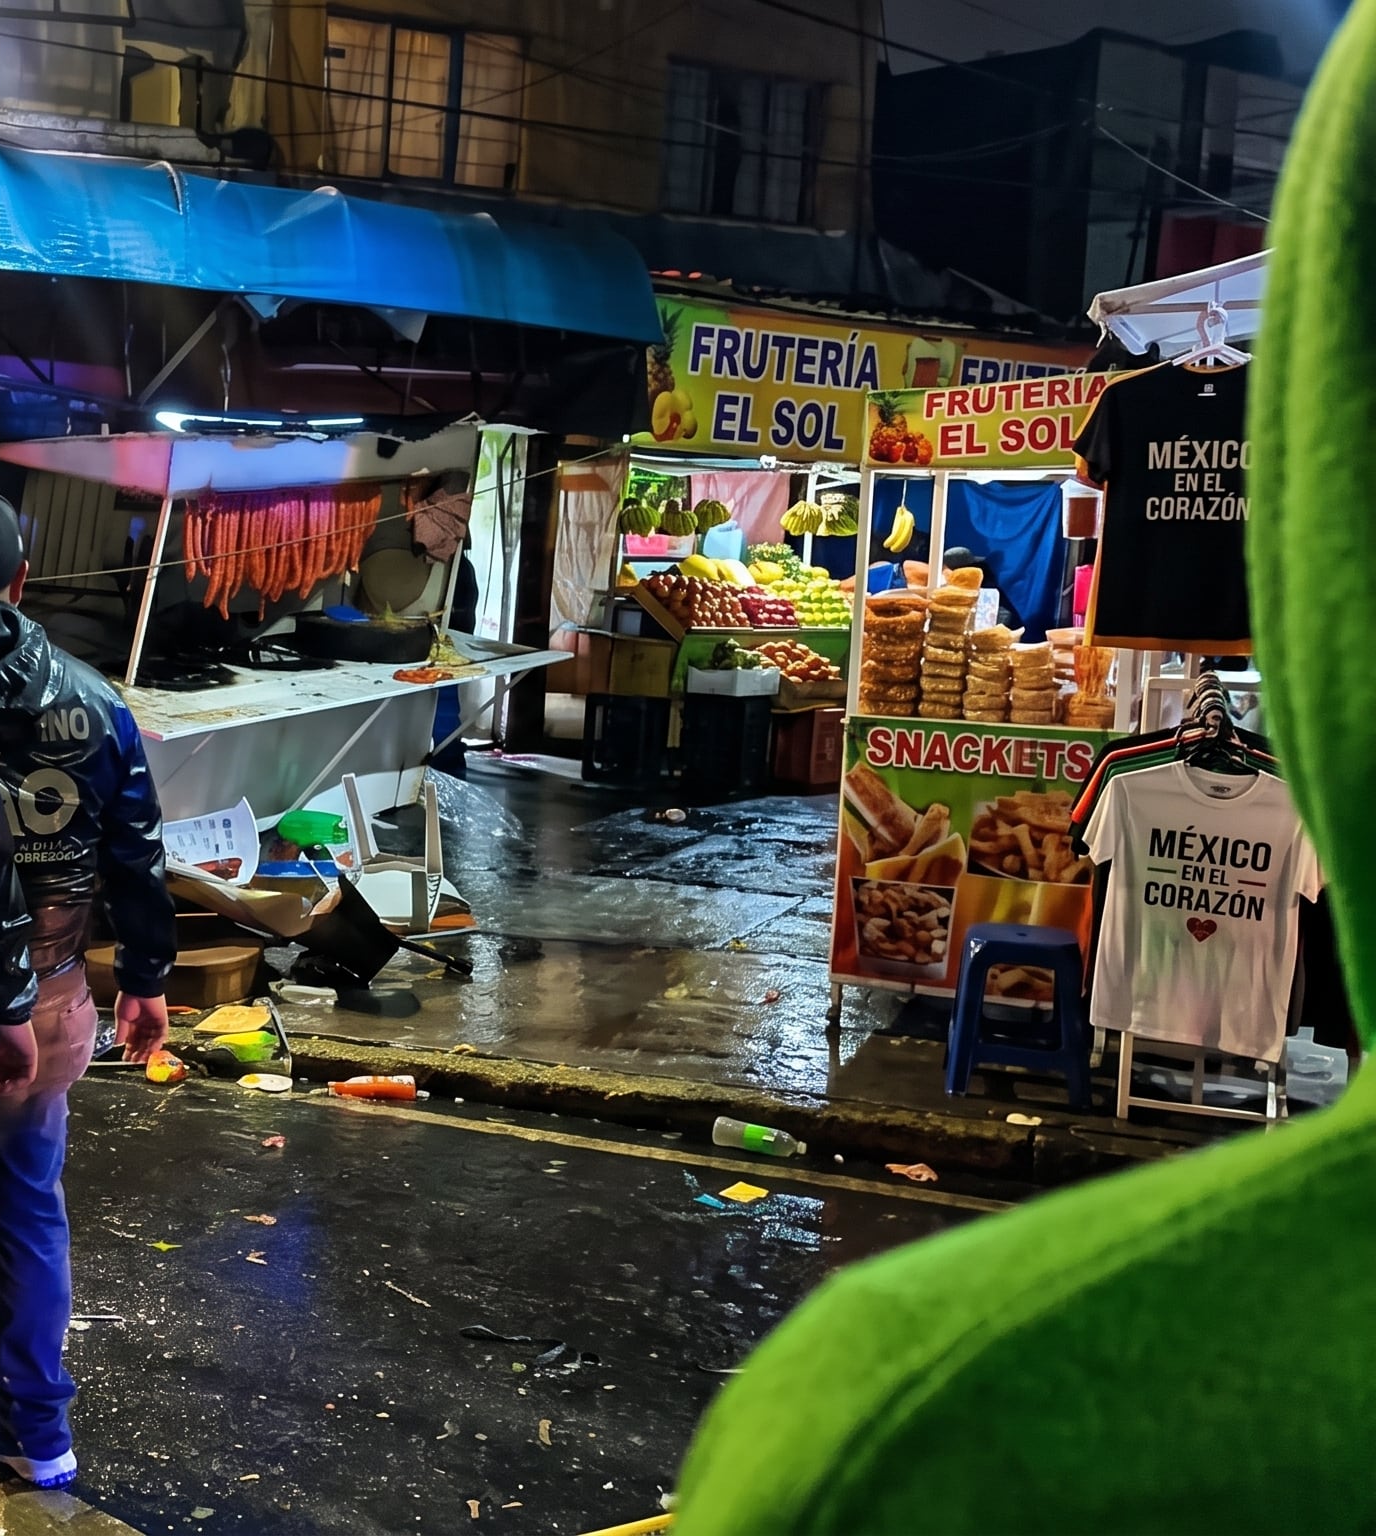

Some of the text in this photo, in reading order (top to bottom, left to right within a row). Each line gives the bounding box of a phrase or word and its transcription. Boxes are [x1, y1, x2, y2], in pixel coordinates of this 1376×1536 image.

[690, 326, 879, 390] FRUTERÍA
[926, 368, 1109, 419] FRUTERÍA
[713, 394, 844, 450] EL SOL
[939, 416, 1076, 456] EL SOL
[1174, 473, 1226, 492] EN EL
[1146, 492, 1252, 521] CORAZÓN
[867, 729, 1093, 781] SNACKETS
[1149, 826, 1271, 873] MÉXICO
[1182, 865, 1229, 886] EN EL
[1144, 882, 1264, 921] CORAZÓN
